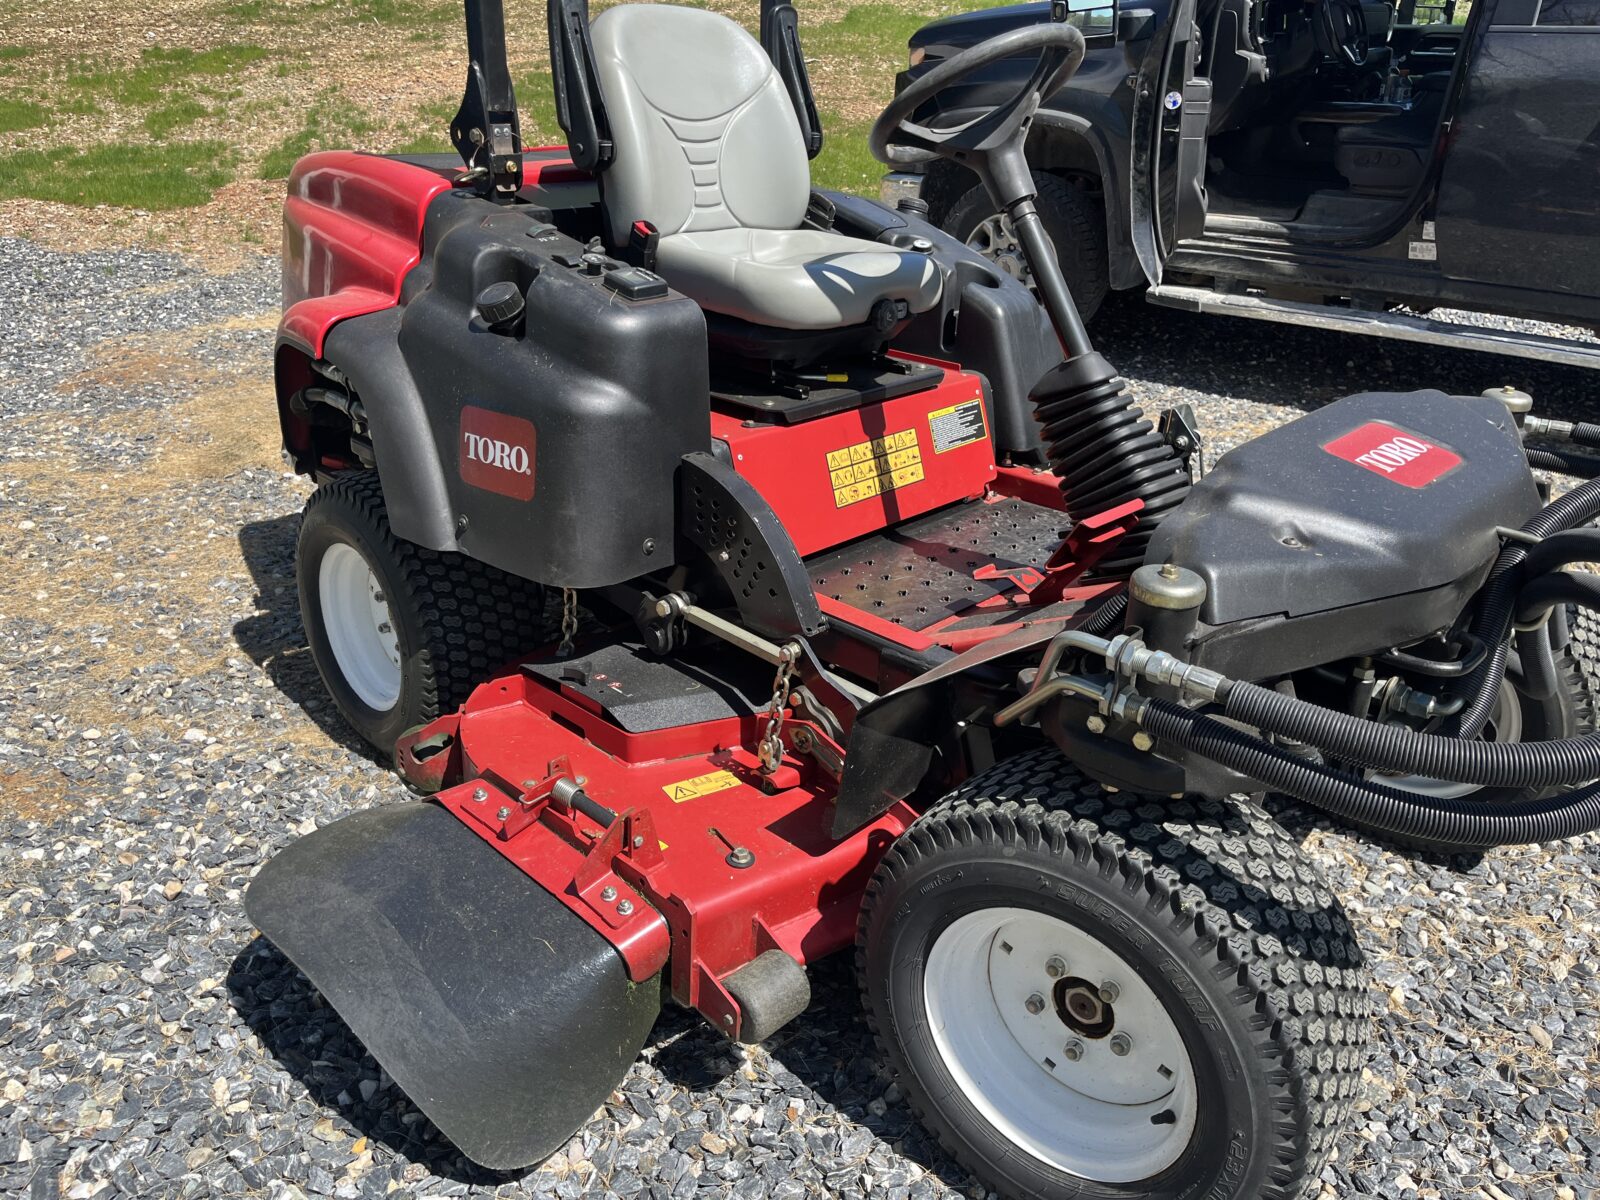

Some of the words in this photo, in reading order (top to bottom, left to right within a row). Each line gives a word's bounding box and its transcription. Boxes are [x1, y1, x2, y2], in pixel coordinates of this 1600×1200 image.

[464, 431, 529, 474] TORO
[1354, 436, 1428, 474] TORO
[1056, 884, 1151, 950] SUPER
[1158, 958, 1221, 1032] TURF
[1208, 1139, 1248, 1200] 23X1
